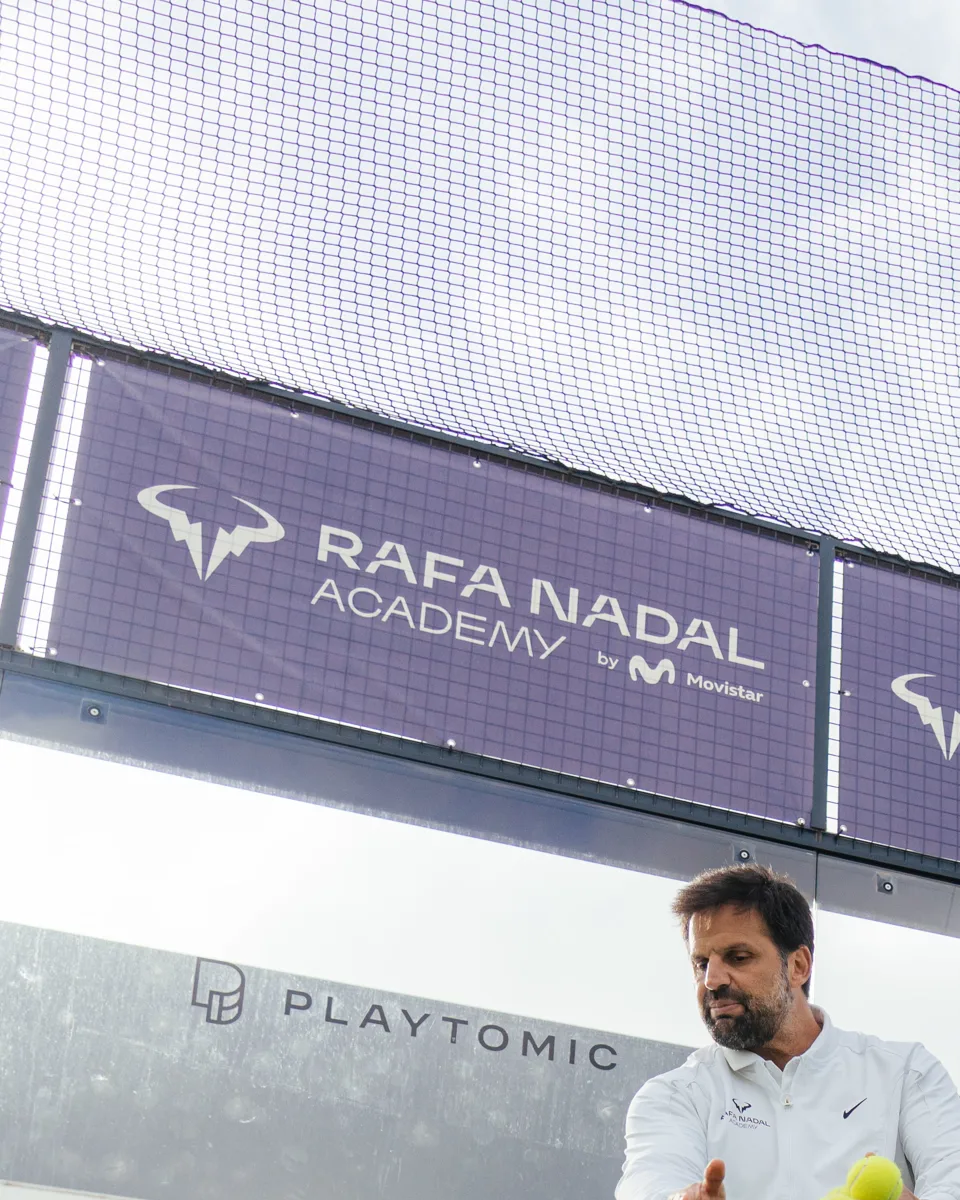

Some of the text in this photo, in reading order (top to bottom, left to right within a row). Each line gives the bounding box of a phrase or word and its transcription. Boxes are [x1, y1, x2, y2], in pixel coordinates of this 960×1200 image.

[311, 578, 567, 660] ACADEMY
[317, 524, 766, 669] RAFA NADAL
[597, 651, 764, 703] by Movistar
[284, 989, 618, 1071] PLAYTOMIC
[739, 1116, 771, 1128] NADAL
